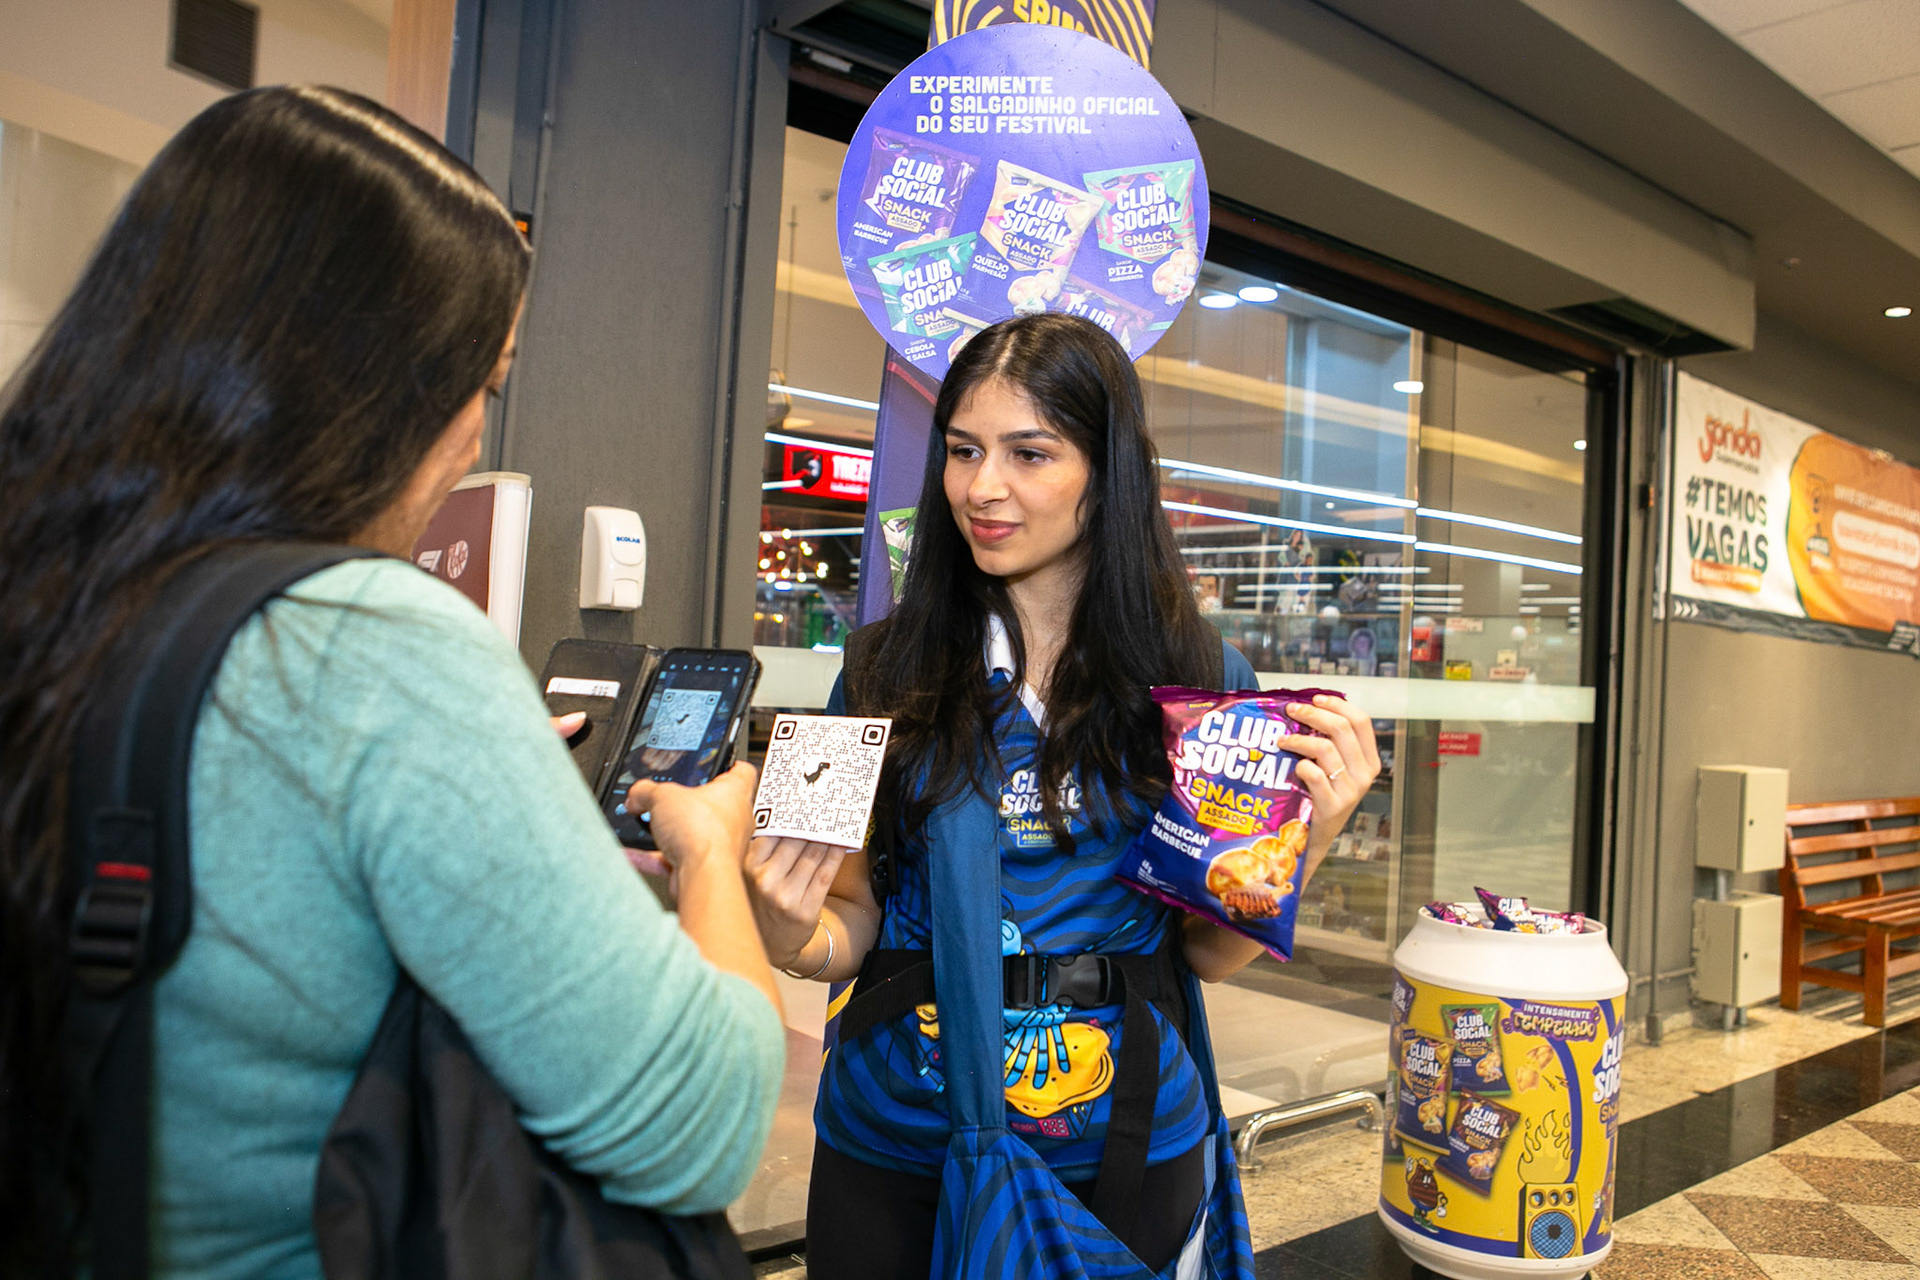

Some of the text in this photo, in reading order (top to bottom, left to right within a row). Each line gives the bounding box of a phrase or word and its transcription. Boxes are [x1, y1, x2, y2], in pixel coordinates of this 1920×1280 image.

[910, 76, 1053, 94] EXPERIMENTE
[930, 95, 1160, 116] O SALGADINHO OFICIAL
[916, 115, 1092, 134] DO SEU FESTIVAL
[892, 156, 944, 185] CLUB
[1116, 183, 1167, 211] CLUB
[883, 200, 932, 222] SNACK
[1014, 193, 1067, 223] CLUB
[853, 222, 893, 239] AMERICAN
[891, 216, 918, 228] ASSADO
[854, 230, 889, 245] BARBECUE
[1003, 232, 1052, 260] SNACK
[1123, 230, 1174, 246] SNACK
[1010, 250, 1037, 264] ASSADO
[1136, 244, 1164, 253] ASSADO
[974, 255, 1009, 273] QUEIJO
[1107, 264, 1143, 277] PIZZA
[903, 259, 953, 291] CLUB
[915, 310, 944, 325] SNA
[904, 342, 935, 355] CEBOLA
[912, 350, 937, 361] SALSA
[1687, 475, 1767, 526] #TEMOS
[1687, 515, 1768, 574] VAGAS
[1198, 710, 1286, 753] CLUB
[1190, 777, 1273, 818] SNACK
[1205, 807, 1247, 825] ASSADO
[1151, 824, 1202, 859] BARBECUE
[1523, 1003, 1592, 1019] INTENSAMENTE
[1456, 1014, 1484, 1028] CLUB
[1513, 1012, 1595, 1037] TEMPERADO
[1410, 1043, 1435, 1060] CLUB
[1470, 1107, 1500, 1125] CLUB
